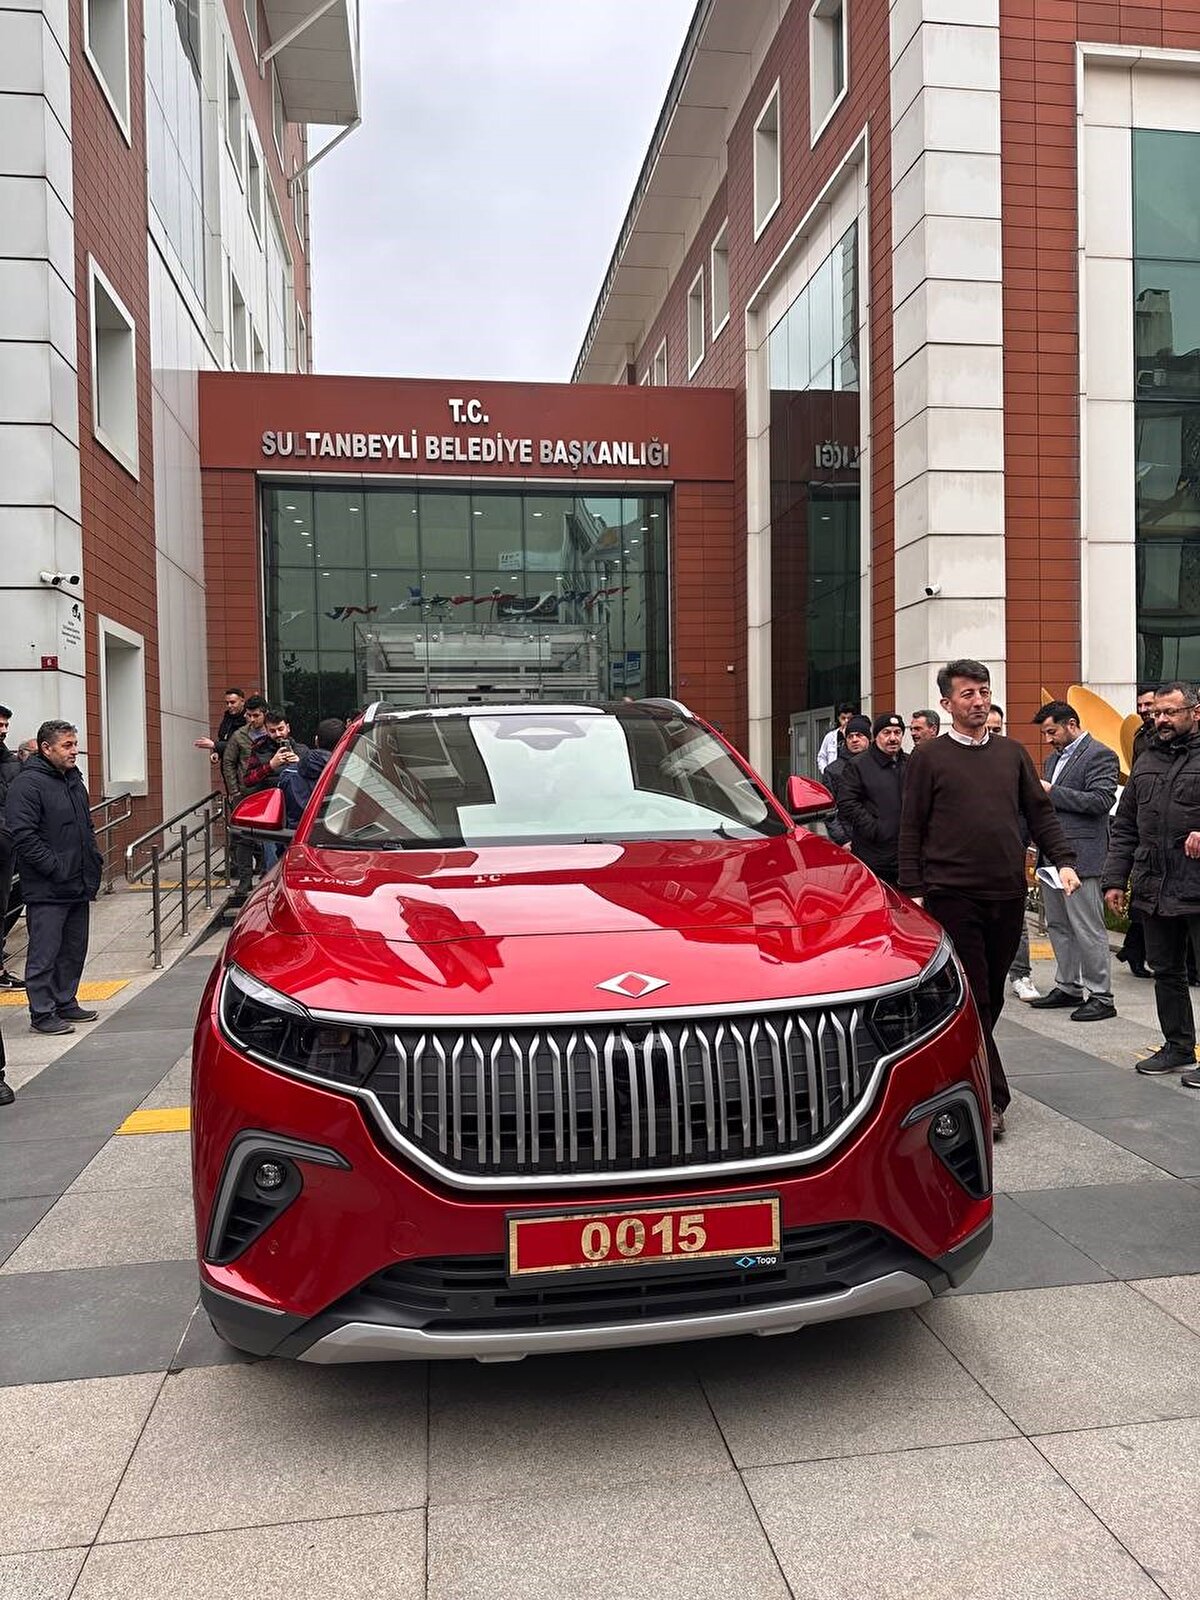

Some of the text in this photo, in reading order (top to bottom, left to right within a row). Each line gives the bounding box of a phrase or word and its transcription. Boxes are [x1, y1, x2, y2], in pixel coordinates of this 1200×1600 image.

[448, 398, 489, 424] T.C.
[262, 429, 670, 470] SULTANBEYLİ BELEDİYE BAŞKANLIĞI
[580, 1213, 707, 1261] 0015
[756, 1256, 777, 1265] Togg
